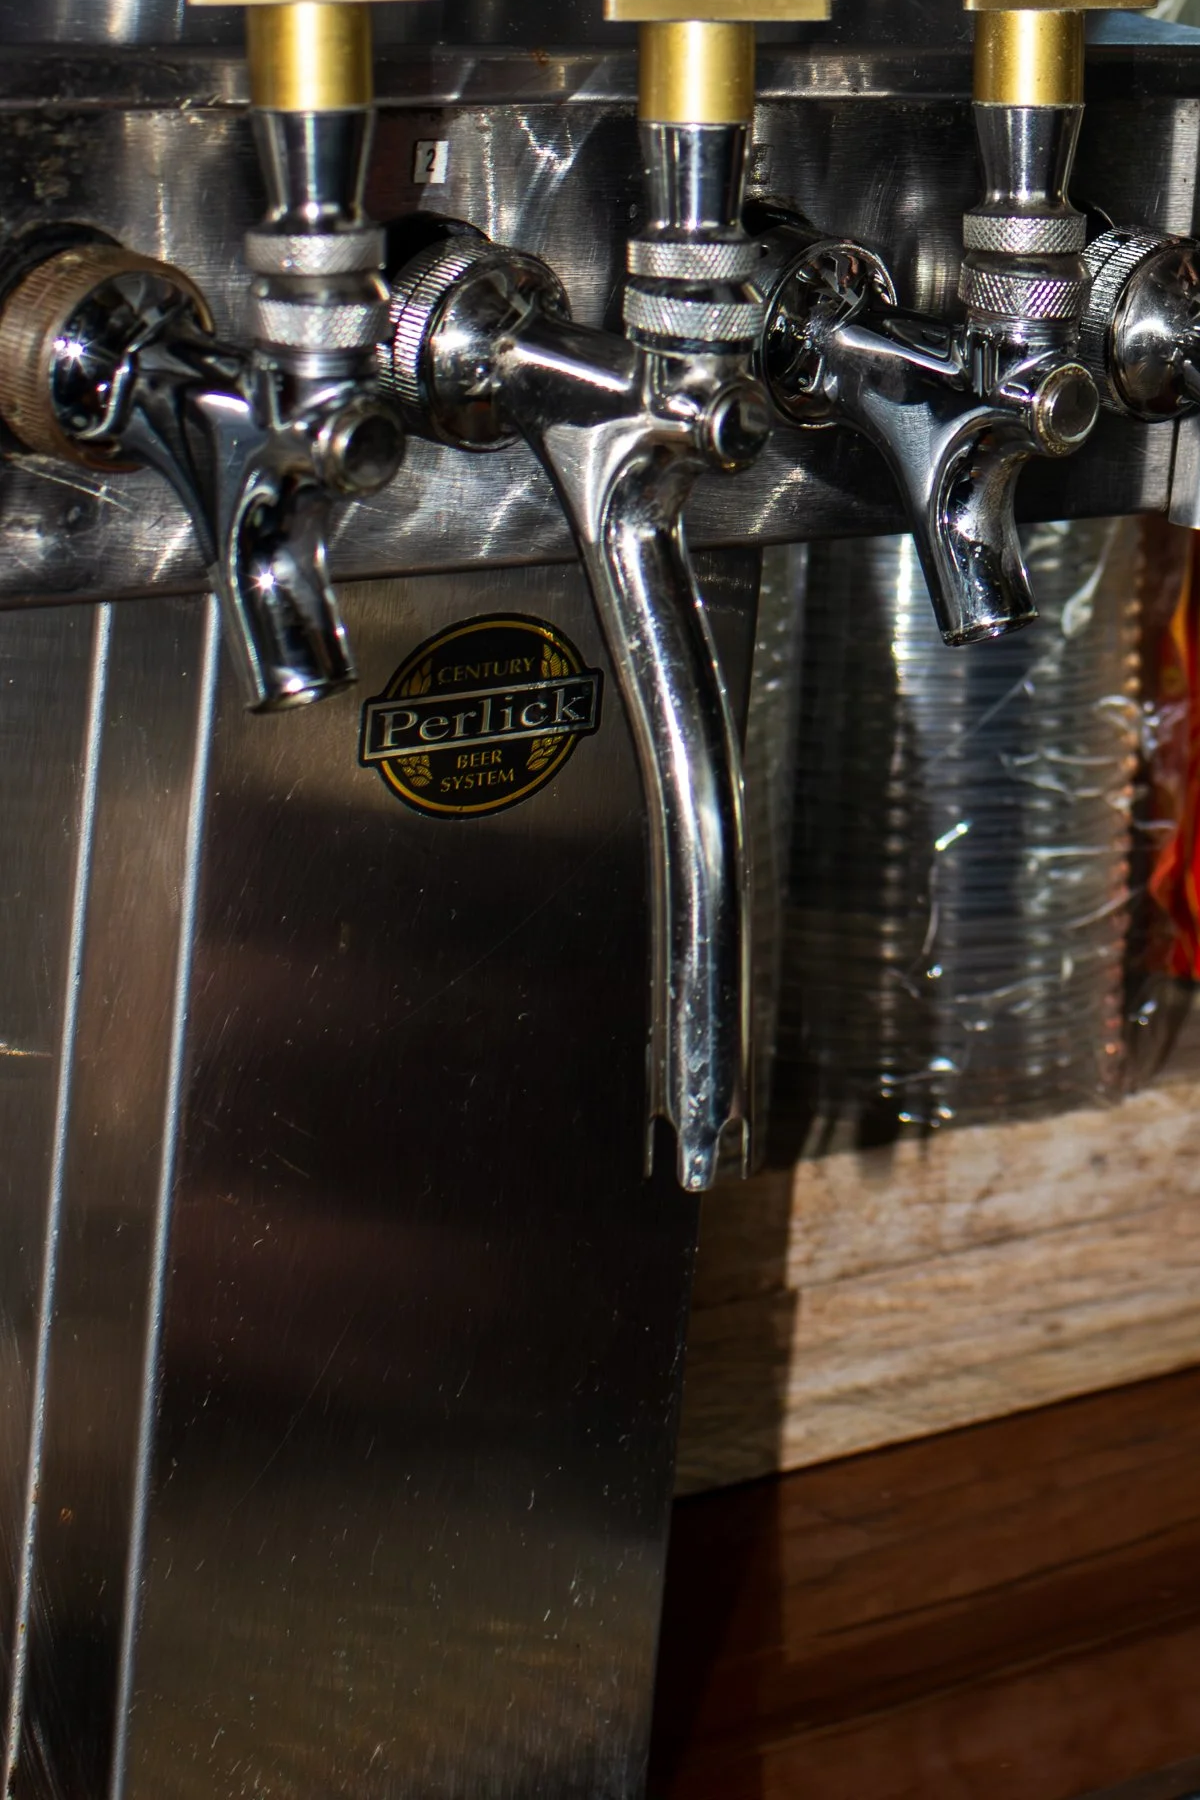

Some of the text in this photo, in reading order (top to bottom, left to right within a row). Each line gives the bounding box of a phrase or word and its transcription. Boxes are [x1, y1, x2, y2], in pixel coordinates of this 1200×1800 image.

[425, 147, 437, 173] 2
[437, 656, 536, 686] CENTURY
[376, 687, 586, 749] Perlick
[456, 749, 503, 770] BEER
[439, 767, 516, 793] SYSTEM
